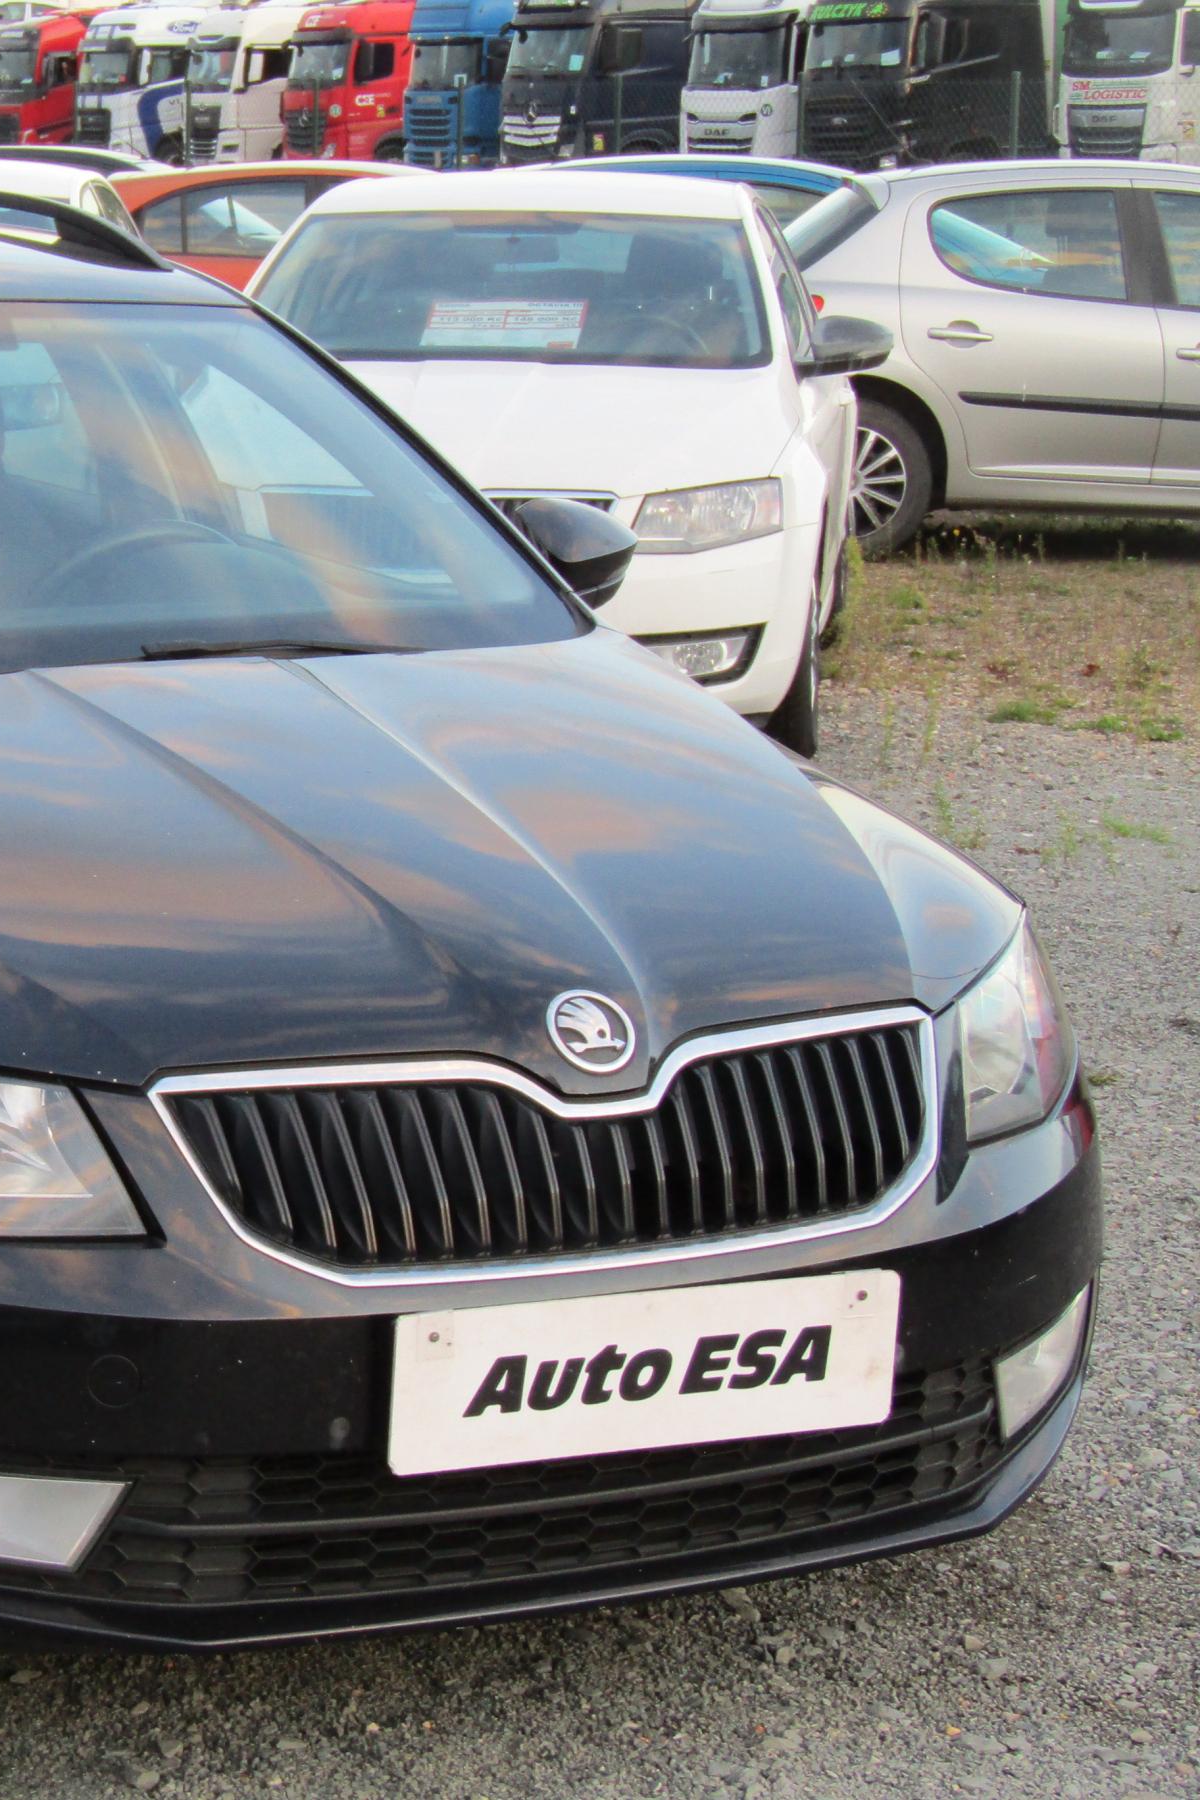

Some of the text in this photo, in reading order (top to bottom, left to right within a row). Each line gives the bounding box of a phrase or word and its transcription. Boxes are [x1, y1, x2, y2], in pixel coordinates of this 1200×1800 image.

[1072, 81, 1091, 91] SM
[704, 128, 729, 136] DAF
[462, 1324, 832, 1418] Auto ESA
